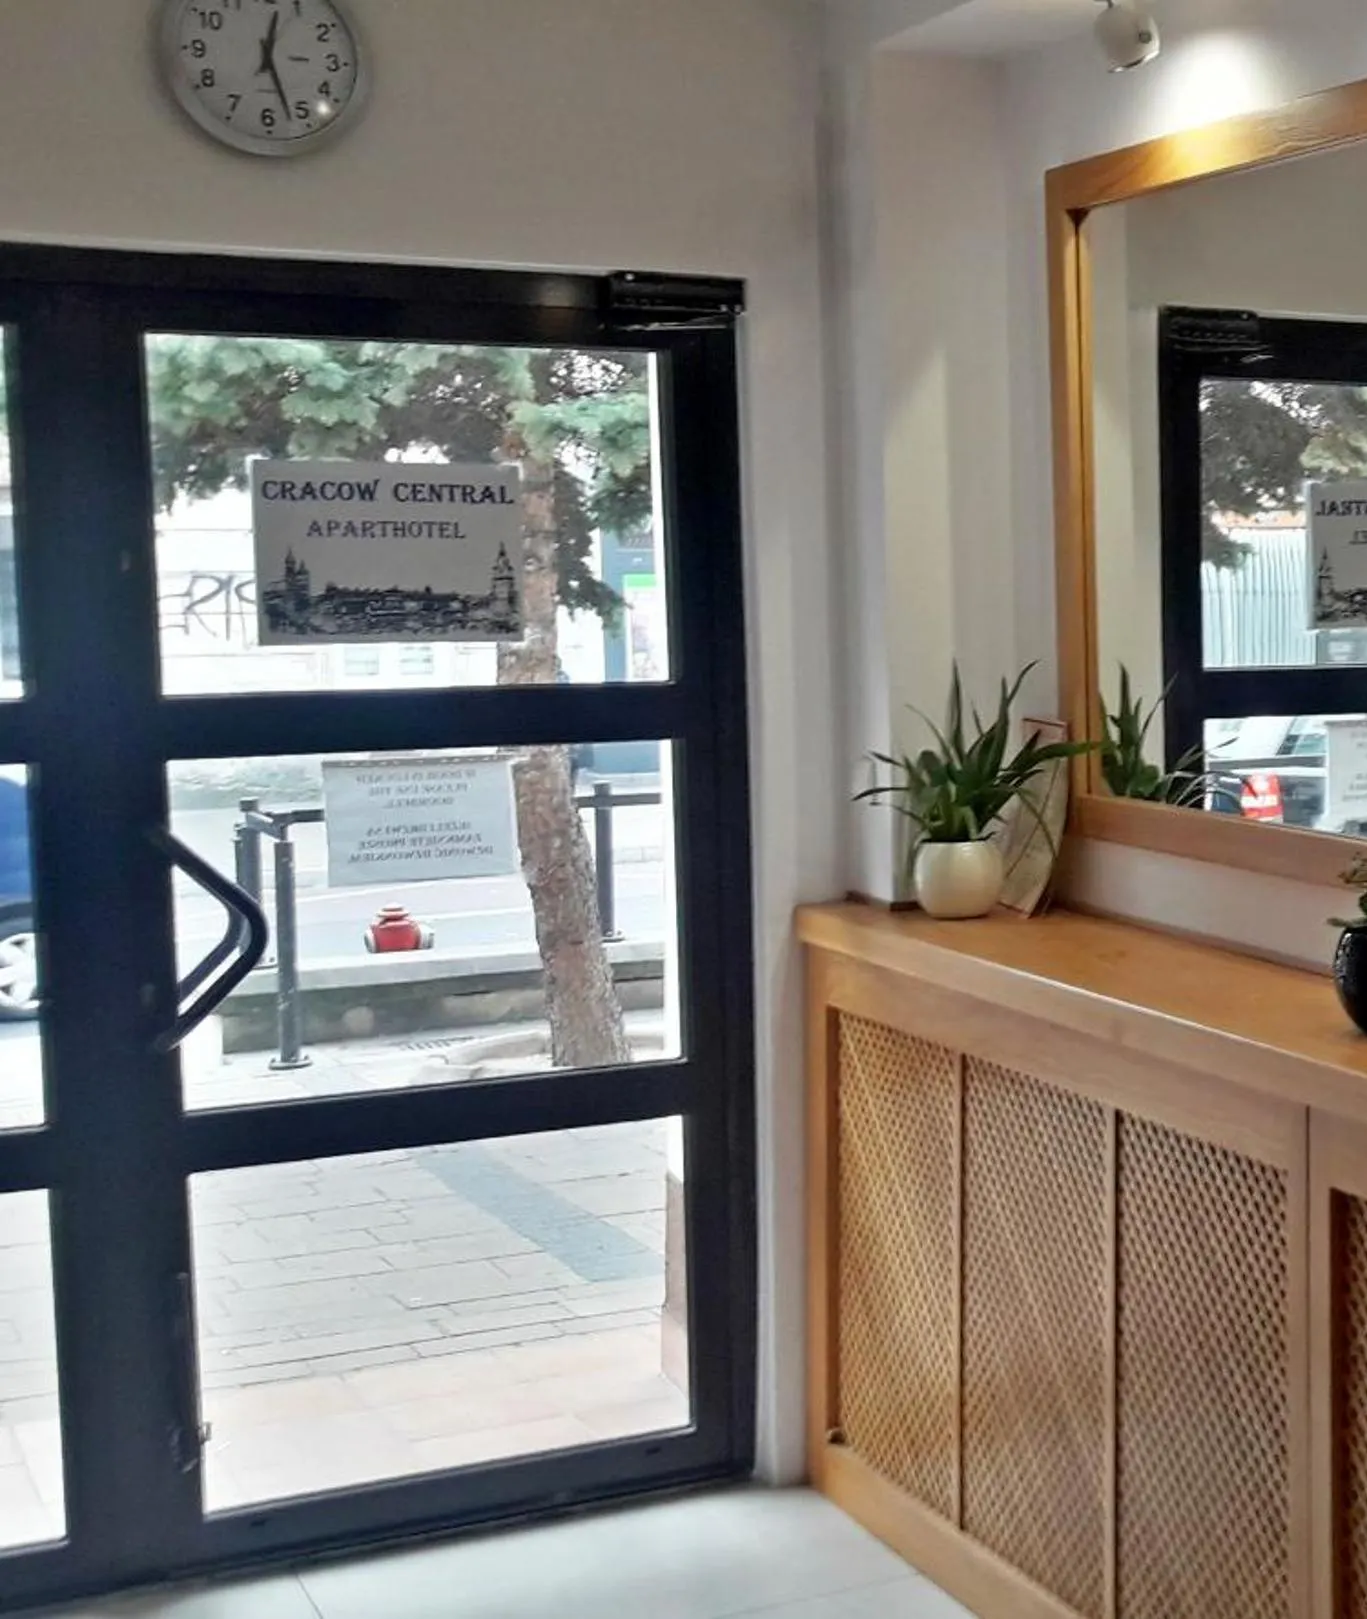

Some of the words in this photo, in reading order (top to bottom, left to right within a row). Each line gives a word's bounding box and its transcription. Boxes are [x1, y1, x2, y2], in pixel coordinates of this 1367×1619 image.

[199, 11, 223, 30] 10
[316, 23, 331, 42] 2
[191, 39, 206, 58] 9
[325, 54, 340, 72] 3
[201, 68, 215, 88] 8
[317, 81, 331, 98] 4
[227, 94, 242, 112] 7
[295, 101, 310, 120] 5
[261, 108, 276, 127] 6
[261, 479, 380, 501] CRACOW
[393, 483, 514, 504] CENTRAL
[306, 520, 466, 539] APARTHOTEL
